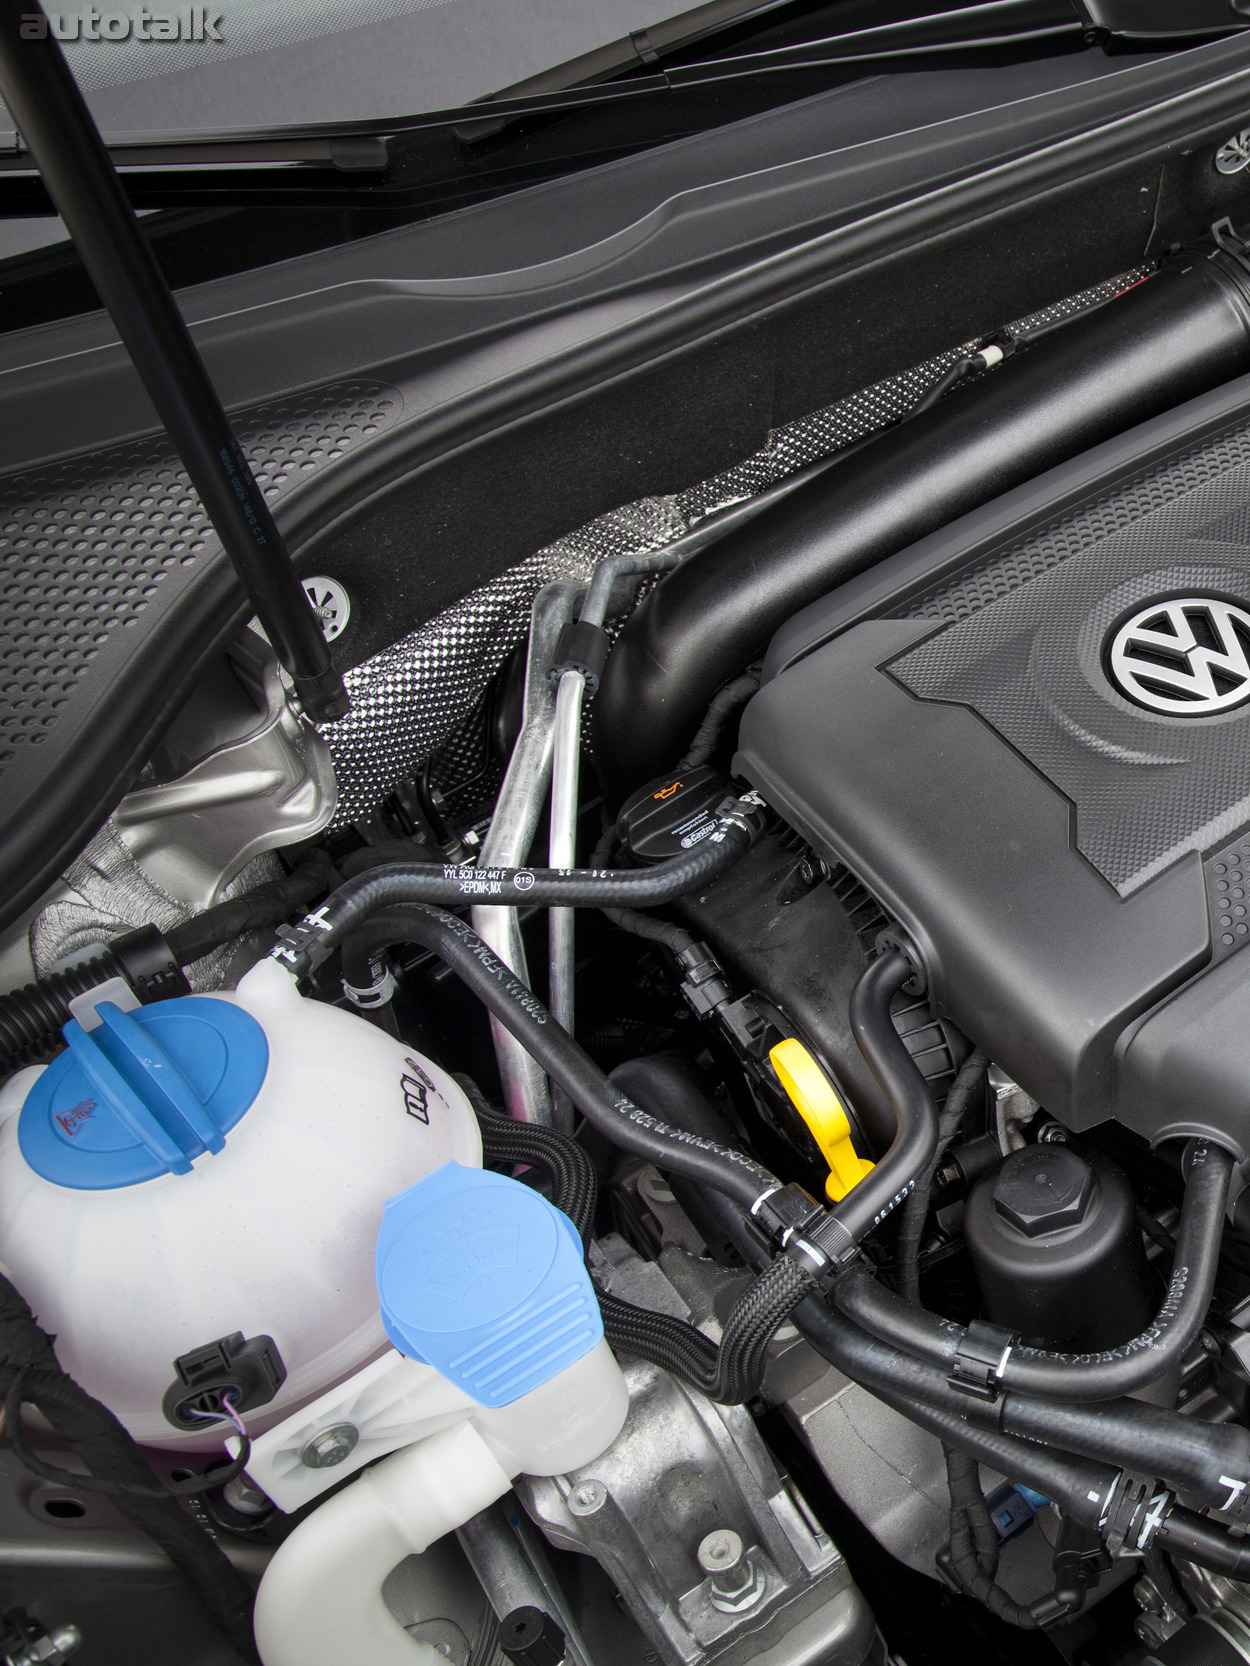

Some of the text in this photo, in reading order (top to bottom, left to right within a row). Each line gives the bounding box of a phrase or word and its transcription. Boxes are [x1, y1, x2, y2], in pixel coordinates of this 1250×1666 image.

[690, 823, 717, 842] Castrol
[443, 870, 458, 880] YYL
[474, 870, 487, 880] 122
